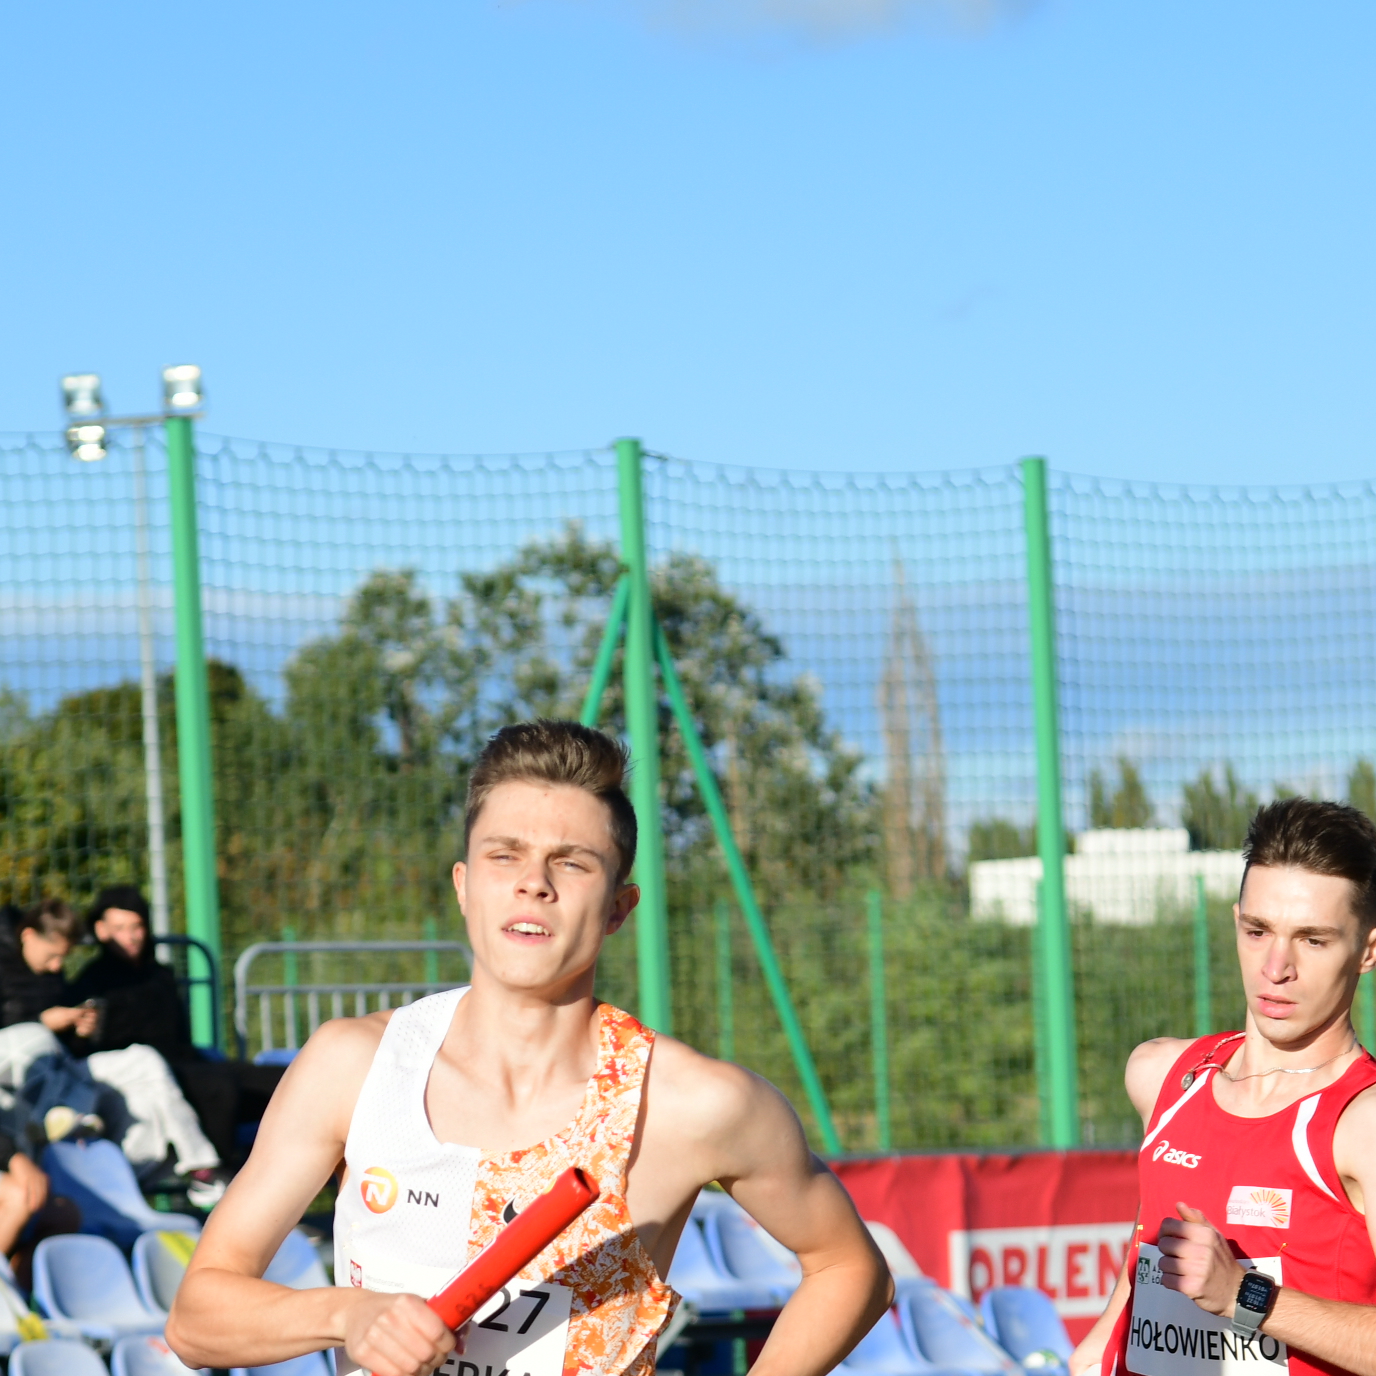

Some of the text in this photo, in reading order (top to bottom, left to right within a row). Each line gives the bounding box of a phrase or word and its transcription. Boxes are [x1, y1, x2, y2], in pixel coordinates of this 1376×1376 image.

[1163, 1148, 1202, 1169] asics
[407, 1188, 440, 1208] NN
[968, 1239, 1129, 1304] ORLEN
[1130, 1316, 1280, 1361] HOŁOWIENKO
